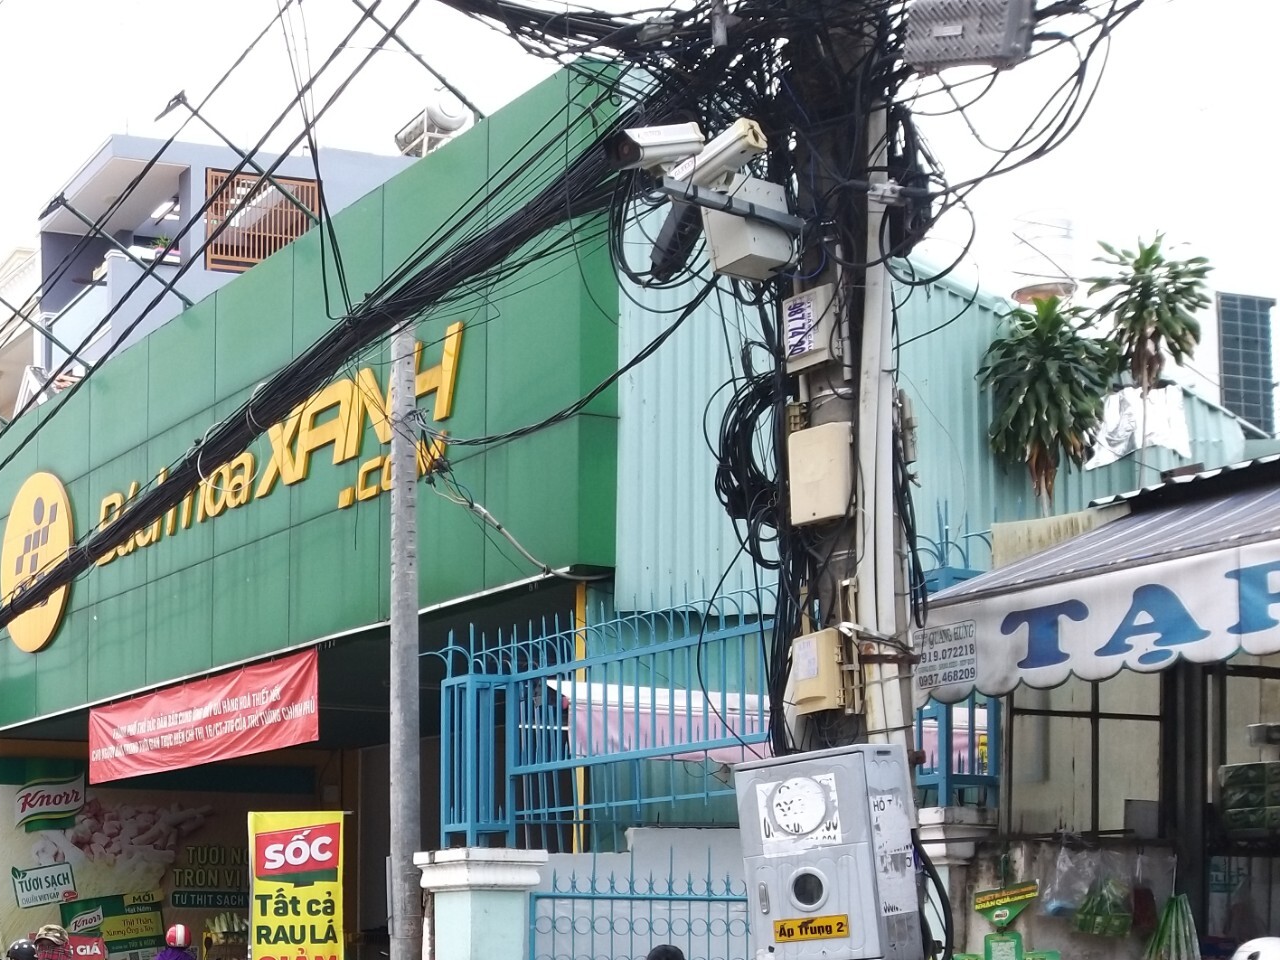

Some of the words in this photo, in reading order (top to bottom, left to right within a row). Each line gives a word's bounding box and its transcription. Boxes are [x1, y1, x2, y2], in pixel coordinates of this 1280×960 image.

[254, 321, 464, 499] XANH
[920, 643, 975, 664] 919.072218
[20, 788, 82, 814] Knorr
[264, 829, 333, 870] SỐC
[19, 875, 43, 894] TƯƠI
[44, 871, 71, 891] SẠCH
[255, 887, 301, 917] Tất
[306, 890, 335, 917] cả
[72, 914, 102, 931] Knorr
[256, 925, 306, 945] RAU
[310, 919, 338, 944] LÁ
[798, 921, 833, 938] Trung
[836, 922, 845, 933] 2
[76, 942, 101, 955] GIÁ
